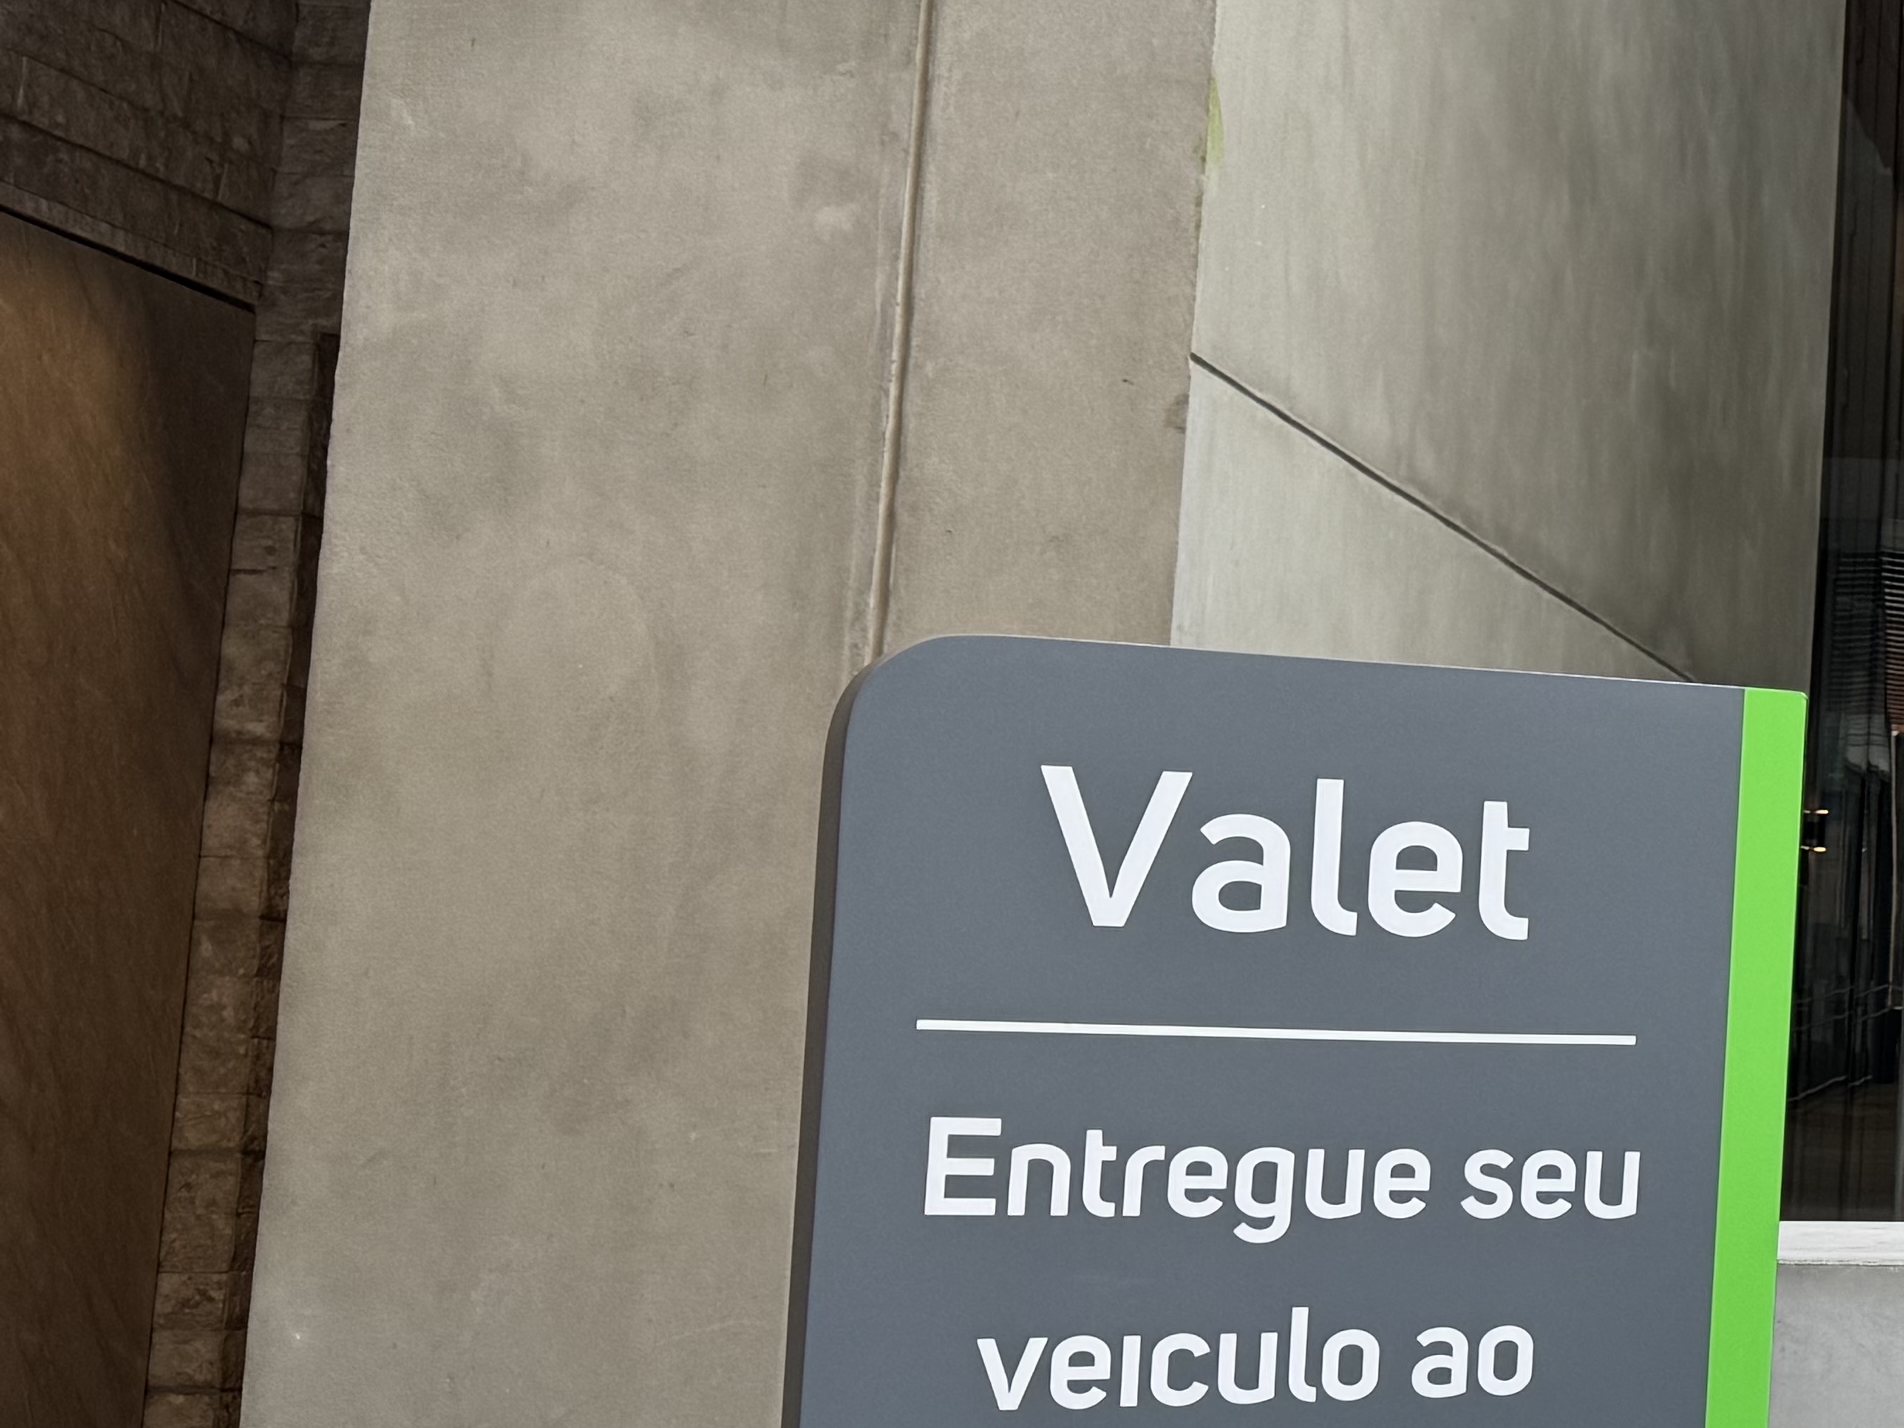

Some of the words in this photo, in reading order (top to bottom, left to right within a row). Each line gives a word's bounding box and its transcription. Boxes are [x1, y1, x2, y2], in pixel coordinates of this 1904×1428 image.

[1039, 764, 1531, 942] Valet
[923, 1115, 1431, 1244] Entregue
[1459, 1148, 1641, 1220] seu
[1411, 1325, 1534, 1400] ao
